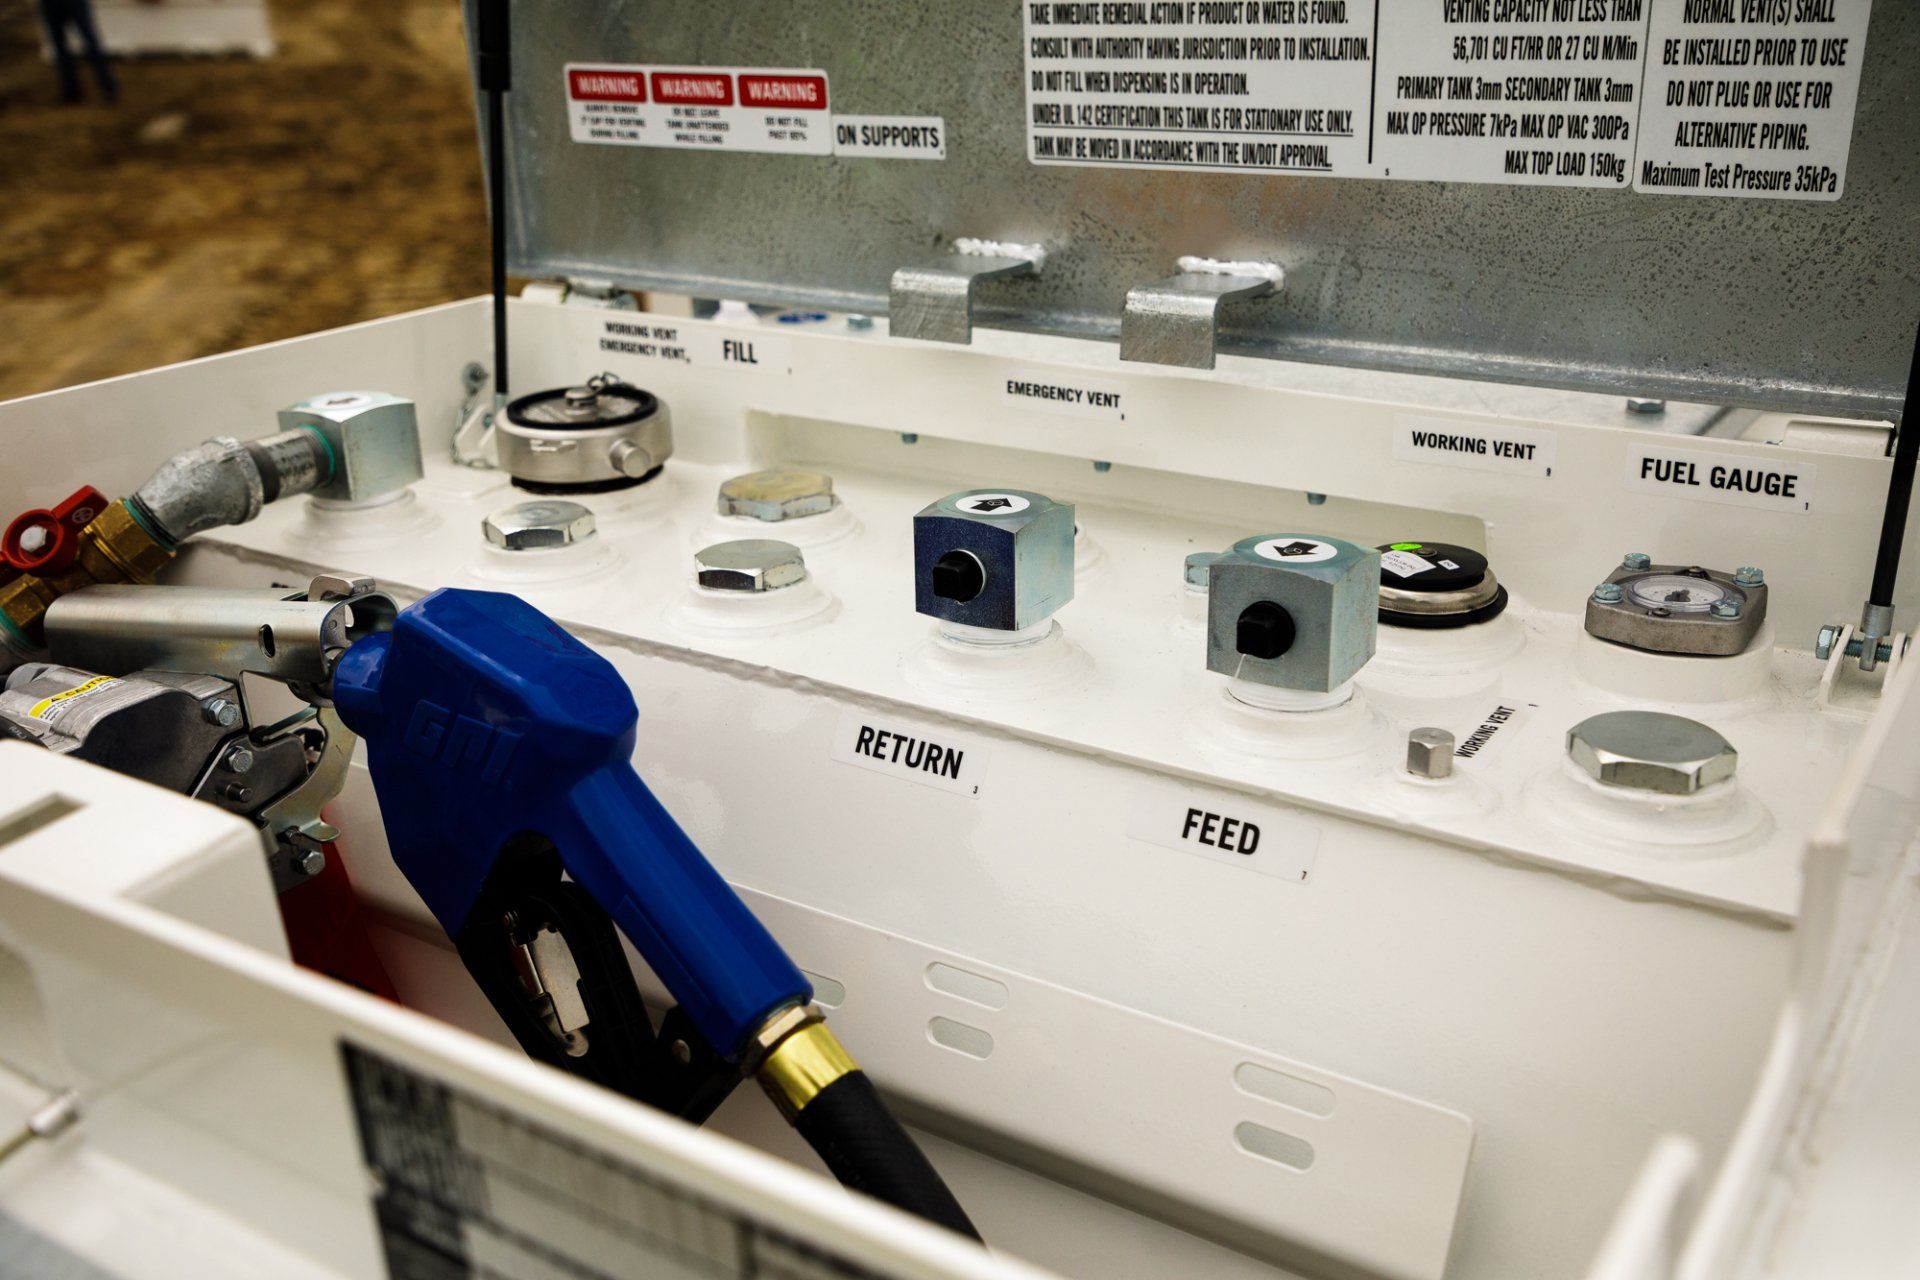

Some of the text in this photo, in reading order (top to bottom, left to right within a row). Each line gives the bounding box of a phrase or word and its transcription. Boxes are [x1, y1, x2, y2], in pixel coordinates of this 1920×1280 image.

[1030, 1, 1348, 24] TAKE IMMEDIATE REMEDIAL ACTION IF PRODUCT OR WATER IS FOUND.
[1444, 0, 1641, 23] VENTING CAPACITY NOT LESS THAN
[1684, 0, 1836, 26] NORMAL VENT(S) SHALL
[1031, 37, 1370, 60] CONSULT WITH AUTHORITY HAVING JURISDICTION PRIOR TO INSTALLATION.
[1453, 36, 1638, 63] 56,701 CU FT/HR OR 27 CU M/Min
[1663, 38, 1848, 66] BE INSTALLED PRIOR TO USE
[576, 76, 639, 96] WARNING
[659, 78, 725, 100] WARNING
[748, 80, 818, 102] WARNING
[1032, 70, 1250, 94] DO NOT FILL WHEN DISPENSING IS IN OPERATION.
[1397, 76, 1633, 102] PRIMARY TANK 3mm SECONDARY TANK 3mm
[1666, 80, 1832, 108] DO NOT PLUG OR USE FOR
[1033, 104, 1354, 133] UNDER UL 142 CERTIFICATION THIS TANK IS FOR STATIONARY USE ONLY.
[1387, 112, 1629, 140] MAX OP PRESSURE 7kPa MAX OP VAC 300Pa
[837, 124, 940, 148] ON SUPPORTS
[1675, 121, 1810, 150] ALTERNATIVE PIPING.
[1034, 136, 1332, 168] TANK MAY BE MOVED IN ACCORDANCE WITH THE UN/DOT APPROVAL.
[1504, 150, 1626, 182] MAX TOP LOAD 150kg
[1642, 160, 1838, 192] Maximum Test Pressure 35kPa
[604, 322, 677, 342] WORKING VENT
[600, 339, 656, 357] EMERGENCY
[660, 347, 686, 361] VENT
[723, 340, 758, 364] FILL
[1006, 380, 1120, 408] EMERGENCY VENT
[1412, 430, 1536, 460] WORKING VENT
[1640, 457, 1798, 498] FUEL GAUGE
[65, 675, 114, 698] CAUTIO
[1452, 705, 1516, 758] WORKING VENT
[855, 725, 964, 780] RETURN
[1182, 808, 1260, 856] FEED
